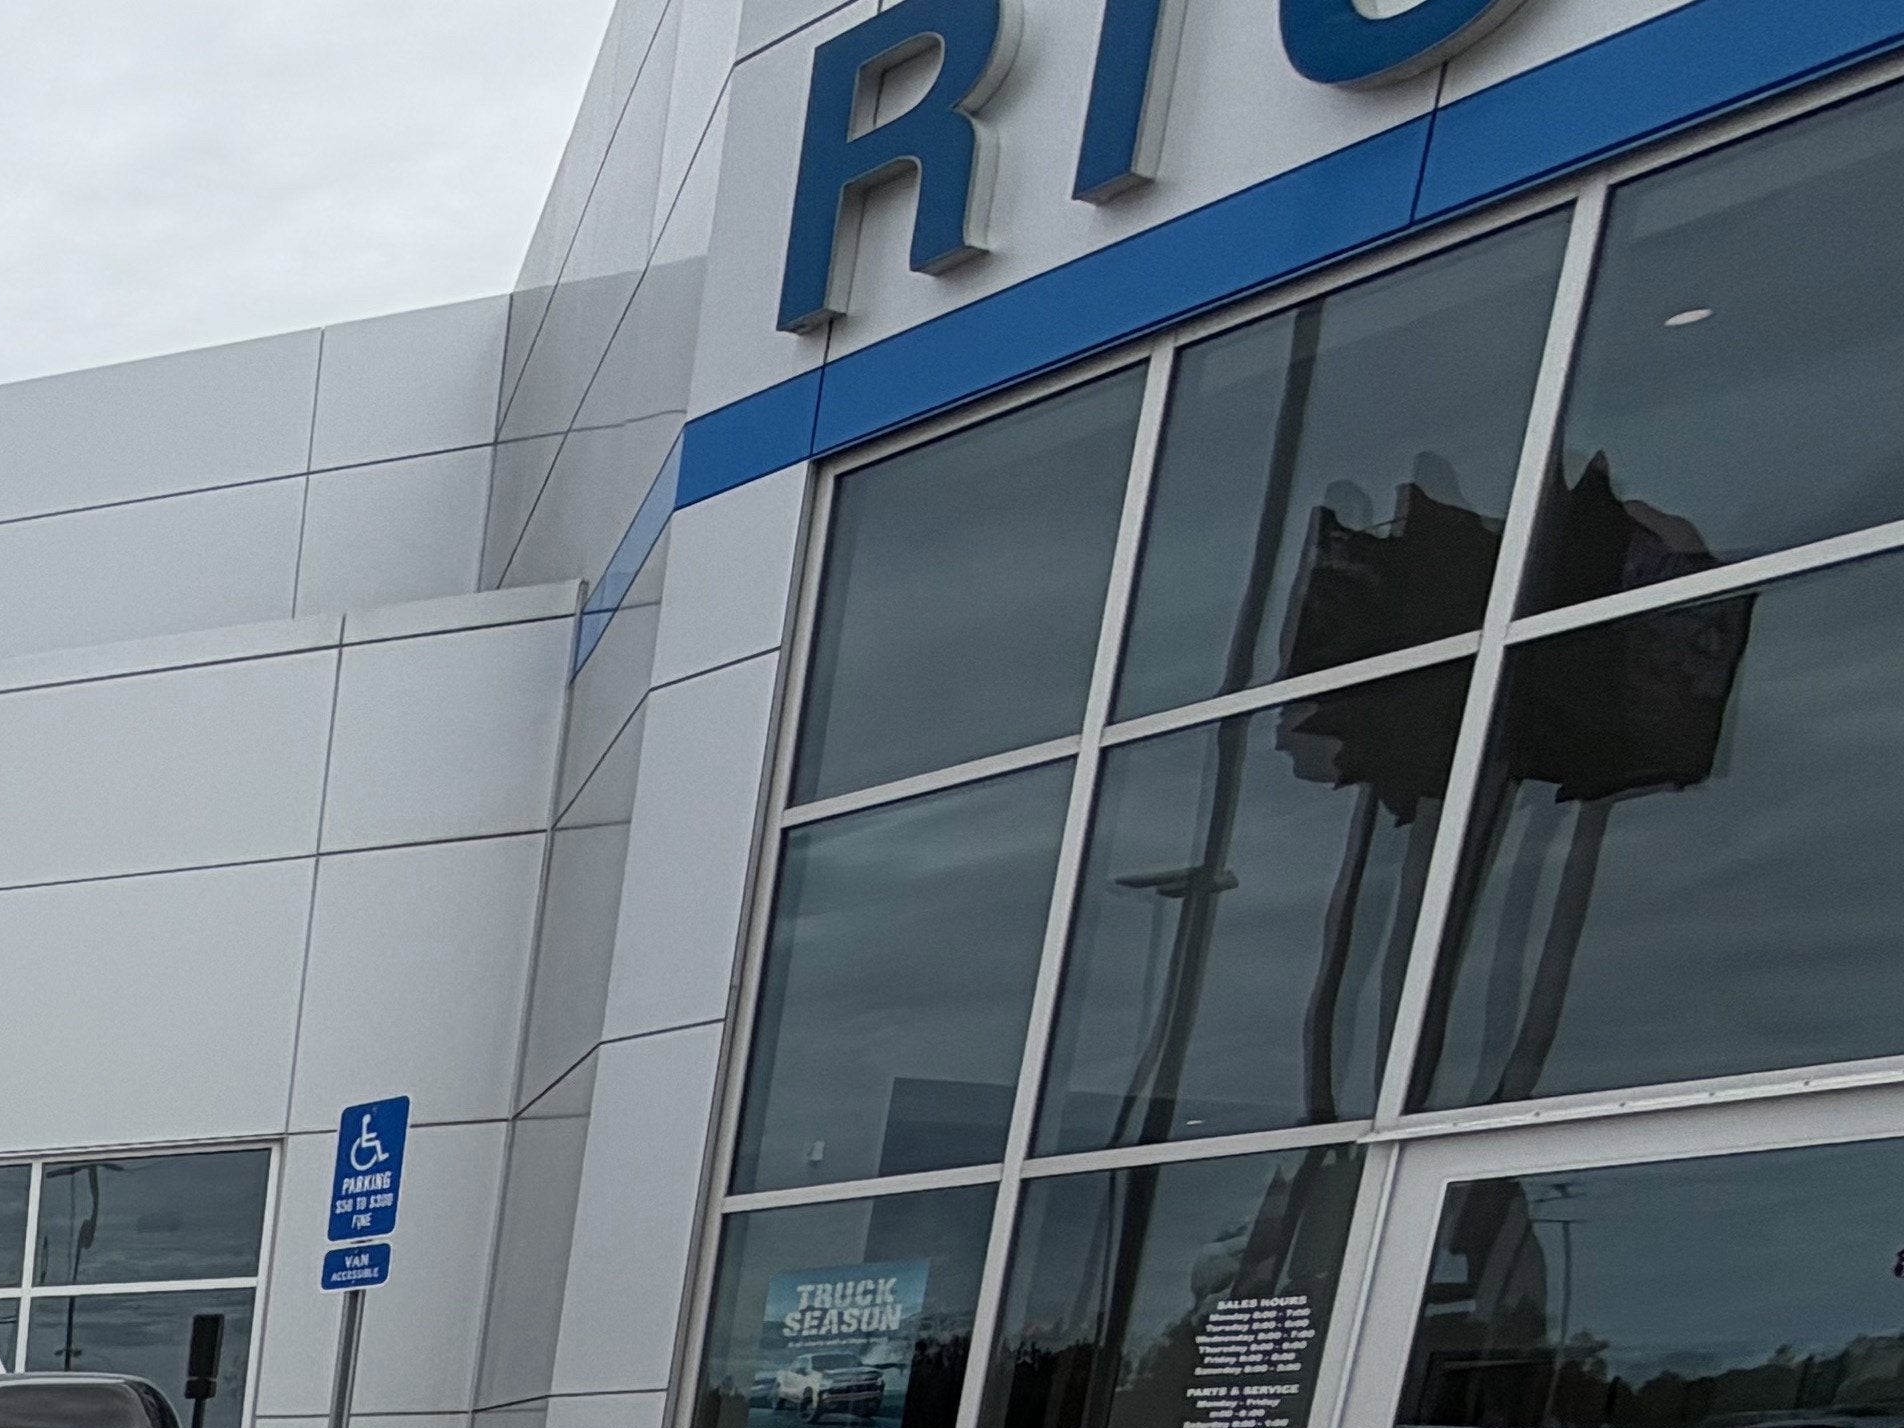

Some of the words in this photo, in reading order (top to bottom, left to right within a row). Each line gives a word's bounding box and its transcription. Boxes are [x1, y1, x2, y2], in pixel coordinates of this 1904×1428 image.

[342, 1170, 393, 1195] PARKING
[335, 1198, 354, 1214] $50
[356, 1196, 367, 1211] TO
[351, 1212, 372, 1229] FINE
[345, 1253, 370, 1267] VAN
[330, 1266, 380, 1282] ACCESSIBLE
[796, 1277, 897, 1311] TRUCK
[1217, 1299, 1258, 1310] SALES
[1260, 1295, 1308, 1307] HOURS
[782, 1304, 903, 1337] SEASON
[1186, 1387, 1228, 1397] PARTS
[1230, 1386, 1240, 1396] &
[1243, 1384, 1300, 1395] SERVICE
